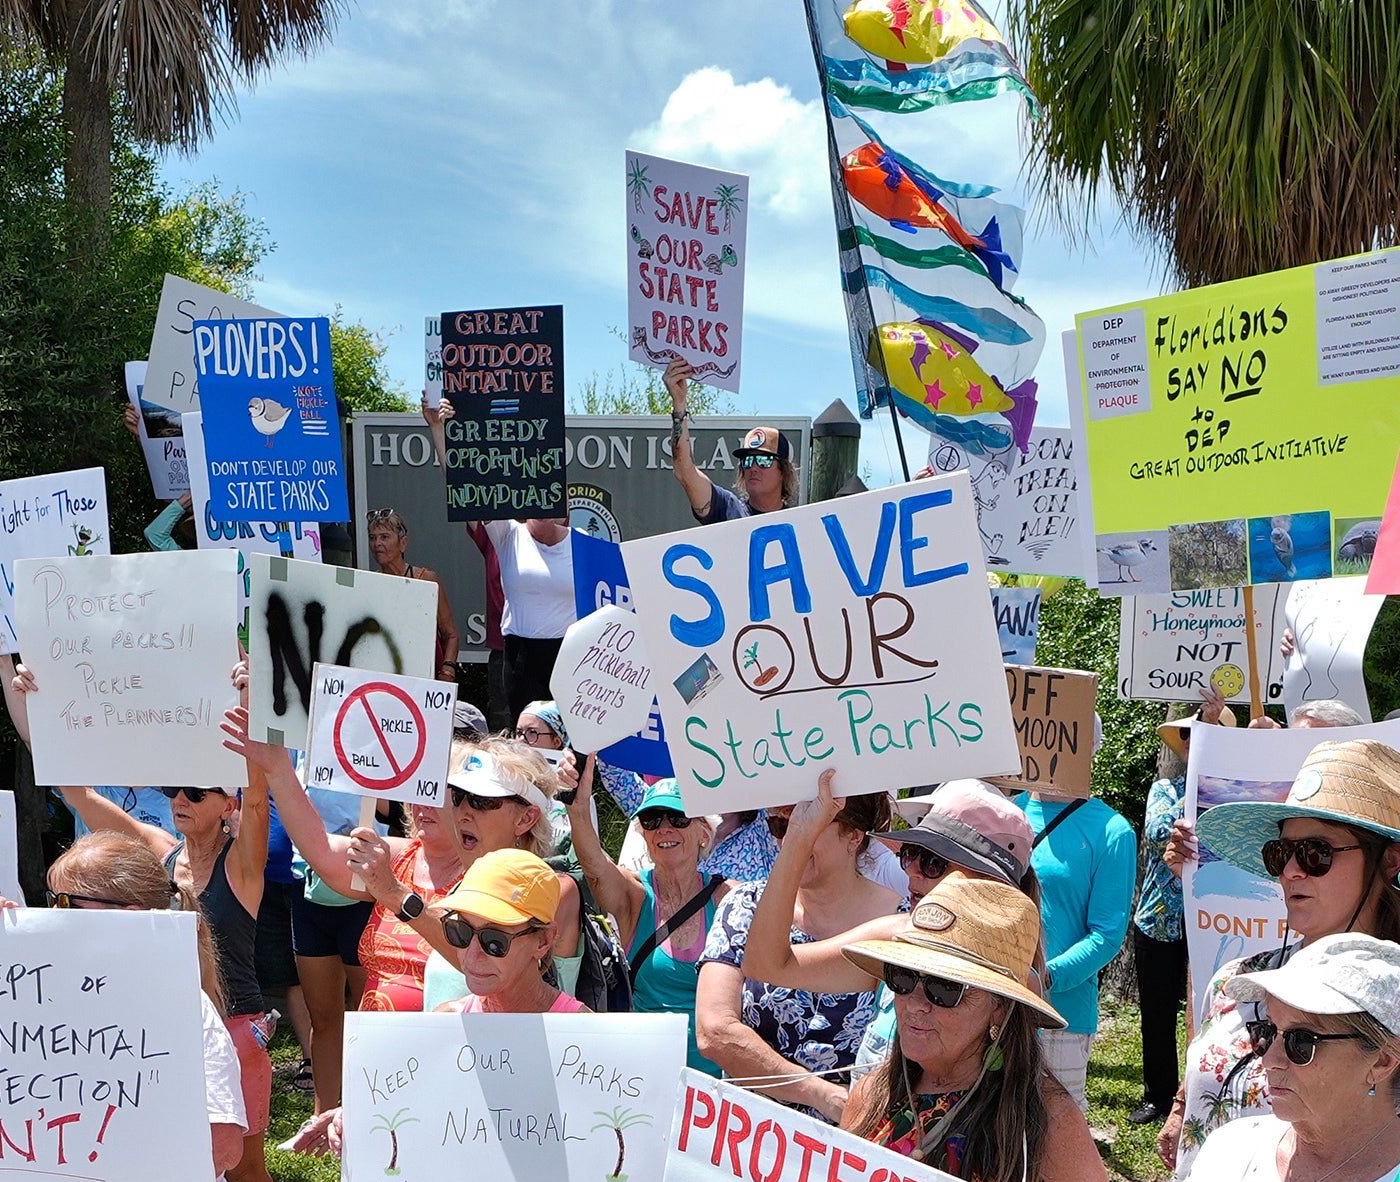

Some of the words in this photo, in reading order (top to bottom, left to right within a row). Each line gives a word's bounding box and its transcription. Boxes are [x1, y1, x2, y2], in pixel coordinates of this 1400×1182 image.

[654, 185, 719, 235] SAVE
[655, 233, 703, 271] OUR
[639, 262, 718, 313] STATE
[454, 310, 544, 335] GREAT
[652, 309, 729, 357] PARKS
[1103, 318, 1124, 331] DEP
[1154, 302, 1288, 359] Floridians
[195, 320, 321, 380] PLOVERS!
[442, 342, 553, 368] OUTDOOR
[1092, 335, 1137, 350] DEPARTMENT
[1110, 352, 1120, 361] OF
[1088, 364, 1145, 379] ENVIRONMENTAL
[1096, 379, 1139, 391] PROTECTION
[1166, 364, 1208, 401] SAY
[1220, 349, 1267, 396] NO
[1098, 394, 1139, 409] PLAQUE
[1190, 406, 1215, 423] to
[445, 418, 549, 443] GREEDY
[1185, 418, 1232, 454] DEP
[211, 460, 249, 476] DON'T
[252, 459, 307, 477] DEVELOP
[312, 459, 338, 476] OUR
[1130, 457, 1181, 480] GREAT
[1186, 446, 1250, 474] OUTDOOR
[1252, 433, 1349, 463] INITIATIVE
[33, 497, 51, 521] for
[51, 489, 98, 525] Those
[227, 479, 277, 511] STATE
[280, 478, 330, 512] PARKS
[1032, 494, 1070, 514] ON
[661, 488, 970, 648] SAVE
[32, 564, 157, 628] PROTECT
[1170, 586, 1240, 608] SWEET
[48, 633, 94, 662] OUR
[264, 590, 404, 717] NO
[731, 591, 939, 695] OUR
[1175, 641, 1243, 663] NOT
[73, 660, 146, 700] PICKLE
[572, 645, 651, 690] pickleball
[1148, 668, 1209, 690] SOUR
[323, 678, 344, 697] NO!
[424, 690, 452, 711] NO!
[569, 694, 608, 726] here
[576, 678, 626, 709] courts
[58, 700, 95, 731] THE
[380, 718, 414, 734] PICKLE
[685, 708, 835, 788] State
[836, 688, 984, 756] Parks
[351, 753, 381, 768] BALL
[314, 766, 334, 785] NO!
[416, 779, 439, 801] NO!
[1197, 908, 1269, 941] DONT
[81, 976, 108, 995] OF
[362, 1056, 420, 1105] KEEP
[456, 1043, 515, 1075] OUR
[556, 1044, 644, 1099] PARKS
[441, 1106, 587, 1147] NATURAL
